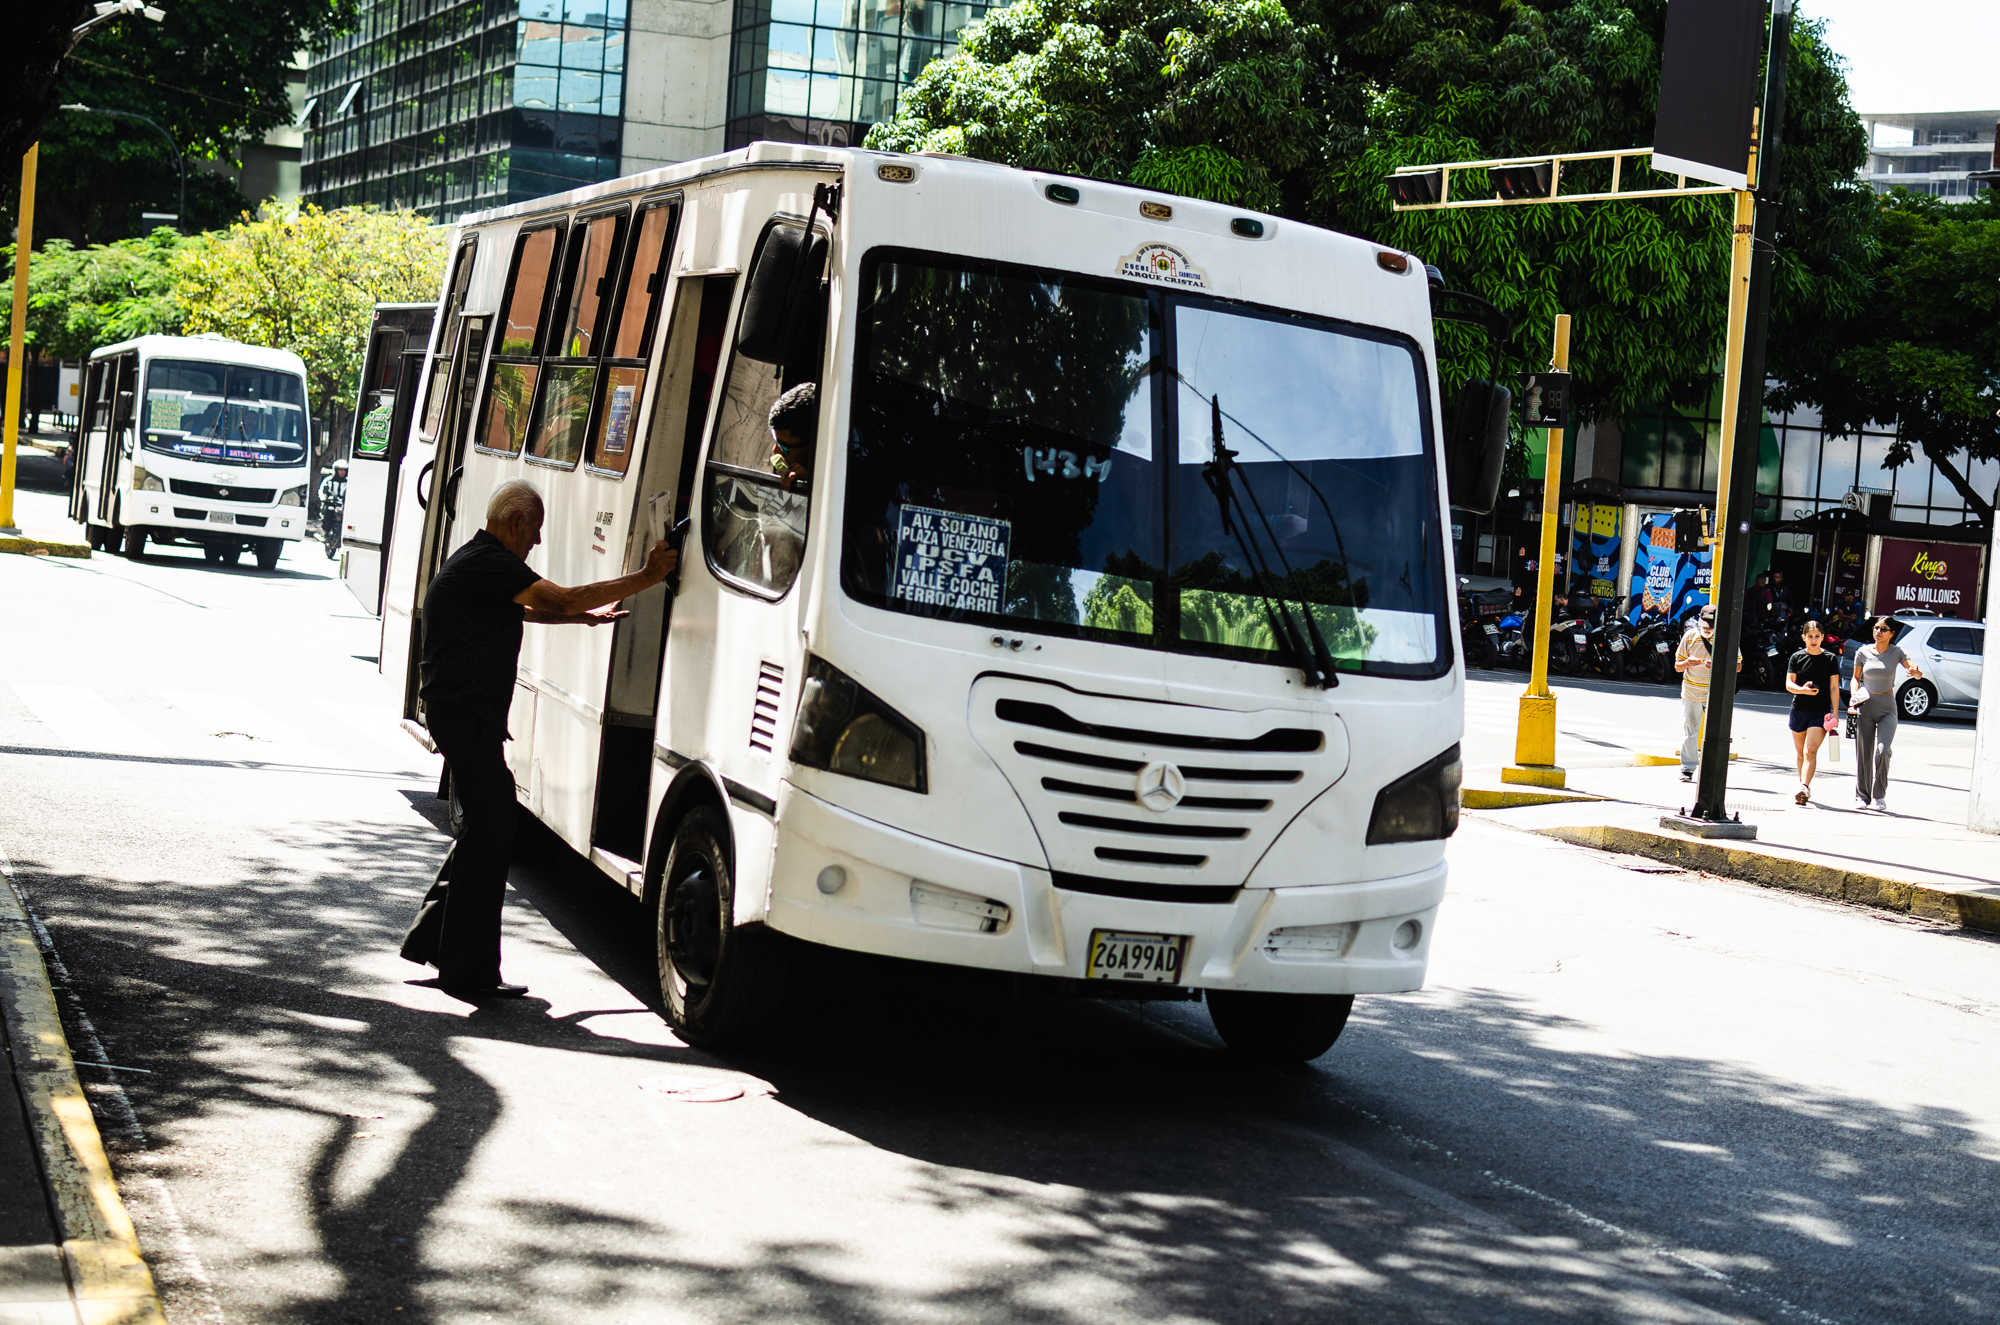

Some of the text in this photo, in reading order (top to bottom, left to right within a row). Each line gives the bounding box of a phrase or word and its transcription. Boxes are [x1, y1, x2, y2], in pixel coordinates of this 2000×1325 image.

[1122, 269, 1206, 288] PARQUE CRISTAL
[1124, 263, 1149, 272] COCHE
[912, 513, 999, 541] AV. SOLANO
[902, 526, 1006, 557] PLAZA VENEZUELA
[916, 543, 989, 566] UCV
[1650, 565, 1671, 577] CLUB
[1694, 576, 1703, 585] UN
[1697, 568, 1712, 577] HOR
[950, 577, 1000, 599] COCHE
[1590, 586, 1615, 598] CONTIGO
[1895, 583, 1961, 605] MÁS MILLONES
[896, 584, 1001, 615] FERROCARRIL
[1093, 942, 1178, 972] 26A99AD
